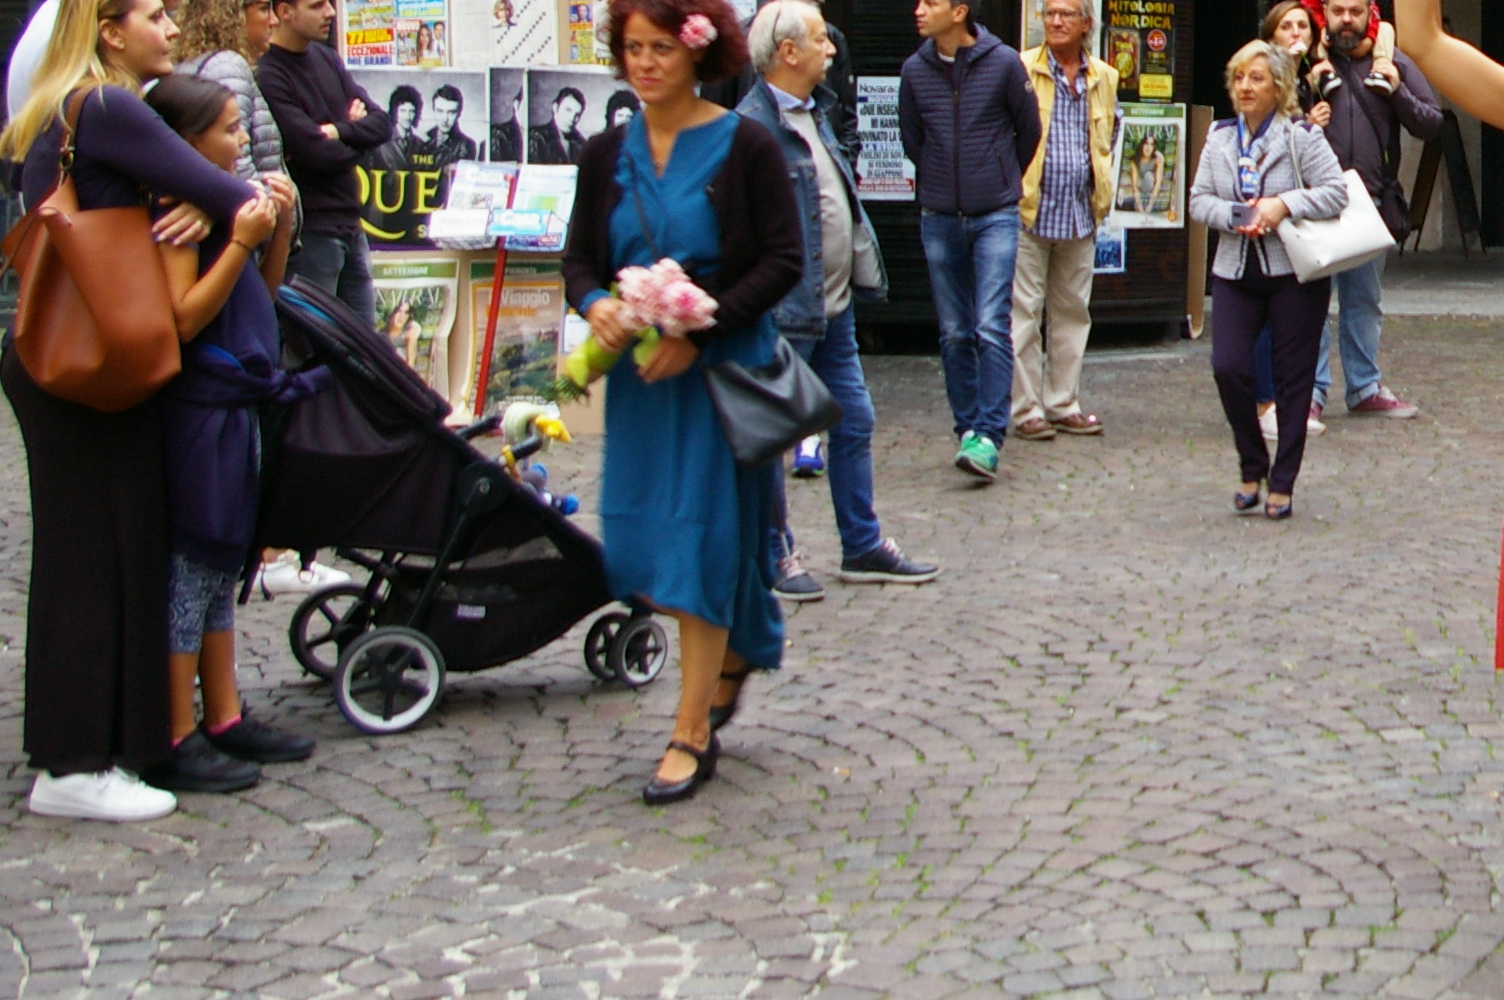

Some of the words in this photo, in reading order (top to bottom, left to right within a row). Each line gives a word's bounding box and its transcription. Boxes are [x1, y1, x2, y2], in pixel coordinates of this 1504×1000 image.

[1108, 0, 1175, 15] MITOLOGIA
[1110, 13, 1171, 29] NORDICA
[412, 154, 434, 165] THE
[383, 266, 429, 276] SETTEMBRE
[501, 288, 550, 307] Viaggio
